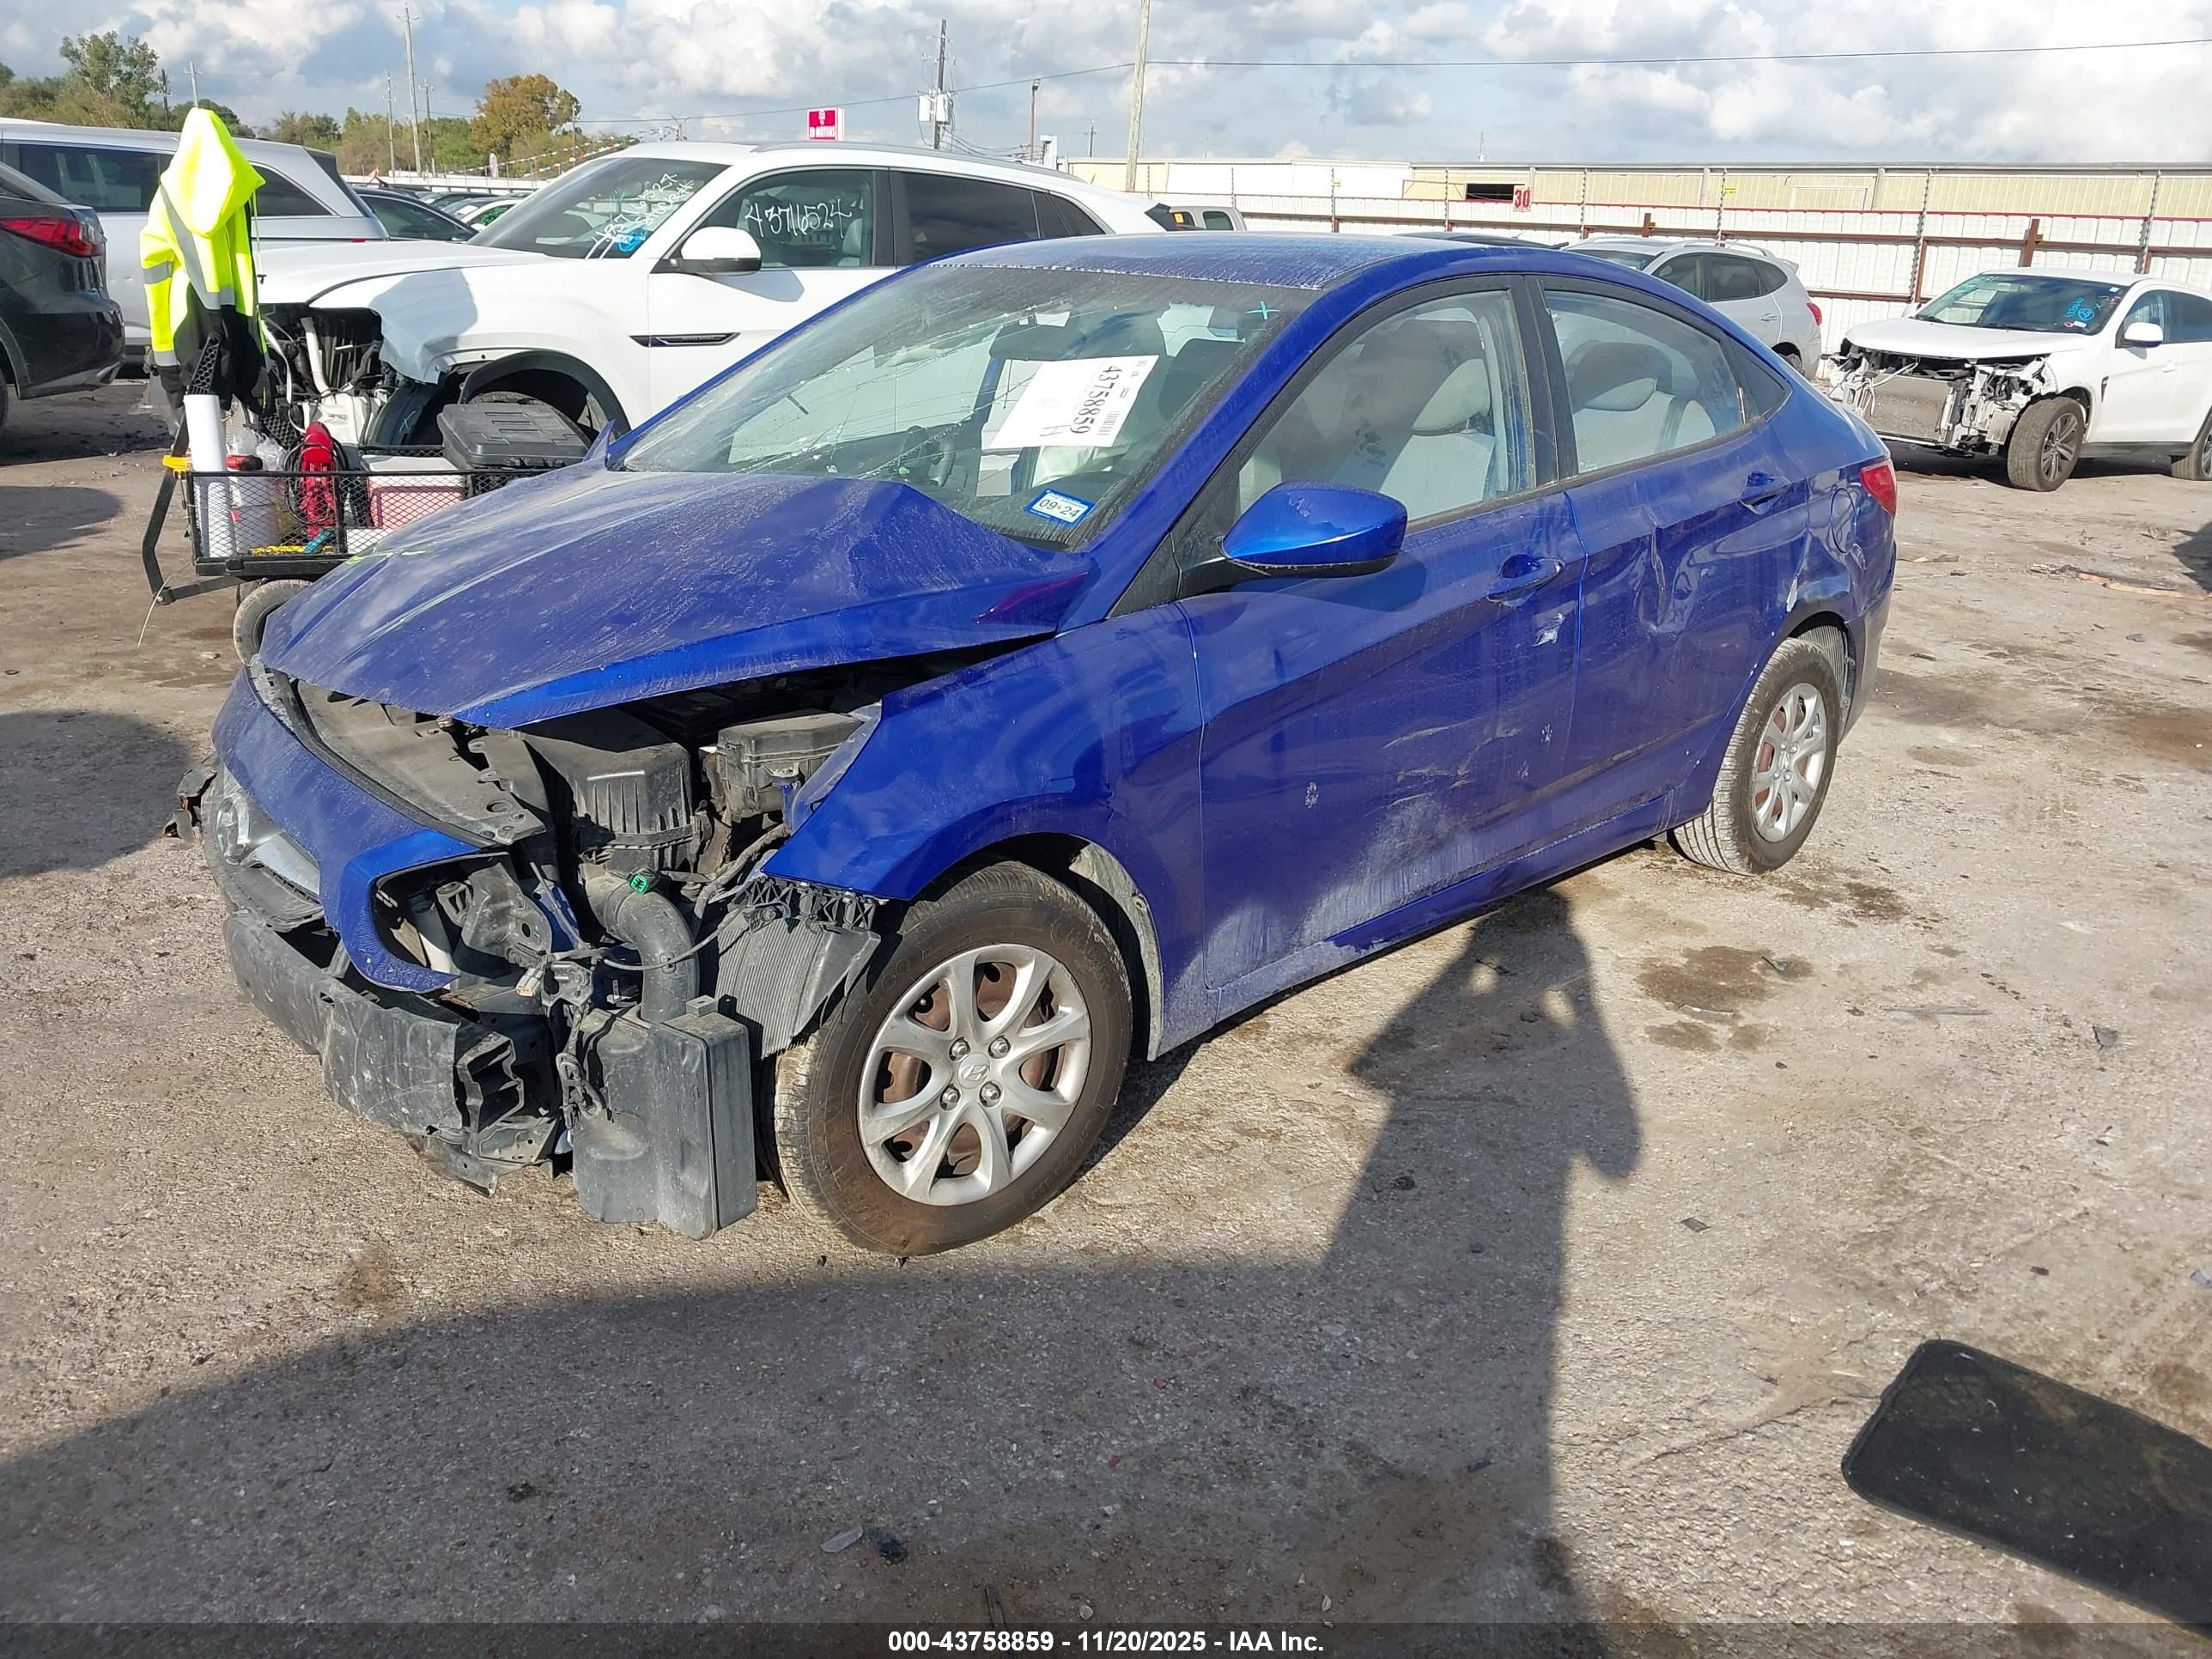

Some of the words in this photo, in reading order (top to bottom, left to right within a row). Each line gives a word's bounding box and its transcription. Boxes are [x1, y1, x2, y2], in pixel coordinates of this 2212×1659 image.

[1515, 189, 1531, 208] 30
[744, 198, 853, 239] 43716524
[1069, 365, 1123, 434] 43758859
[1039, 499, 1058, 510] 09
[1060, 506, 1080, 518] 24
